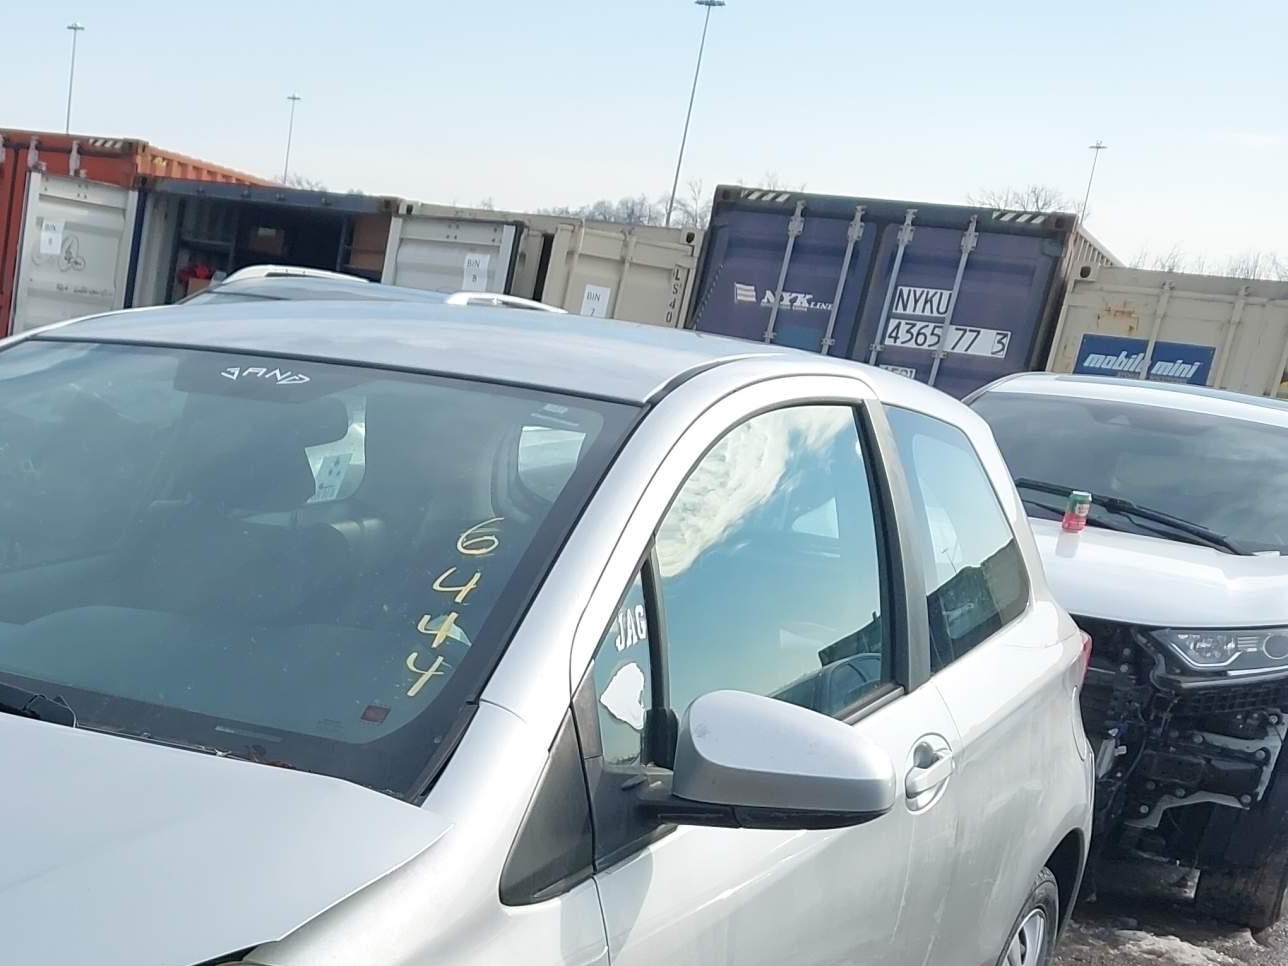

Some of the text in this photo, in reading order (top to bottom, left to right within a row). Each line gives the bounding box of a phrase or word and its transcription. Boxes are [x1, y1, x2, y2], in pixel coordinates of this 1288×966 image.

[761, 289, 813, 307] NYK
[894, 287, 953, 316] NYKU
[991, 332, 1009, 355] 3
[1150, 359, 1200, 378] mini
[406, 517, 504, 697] 6444
